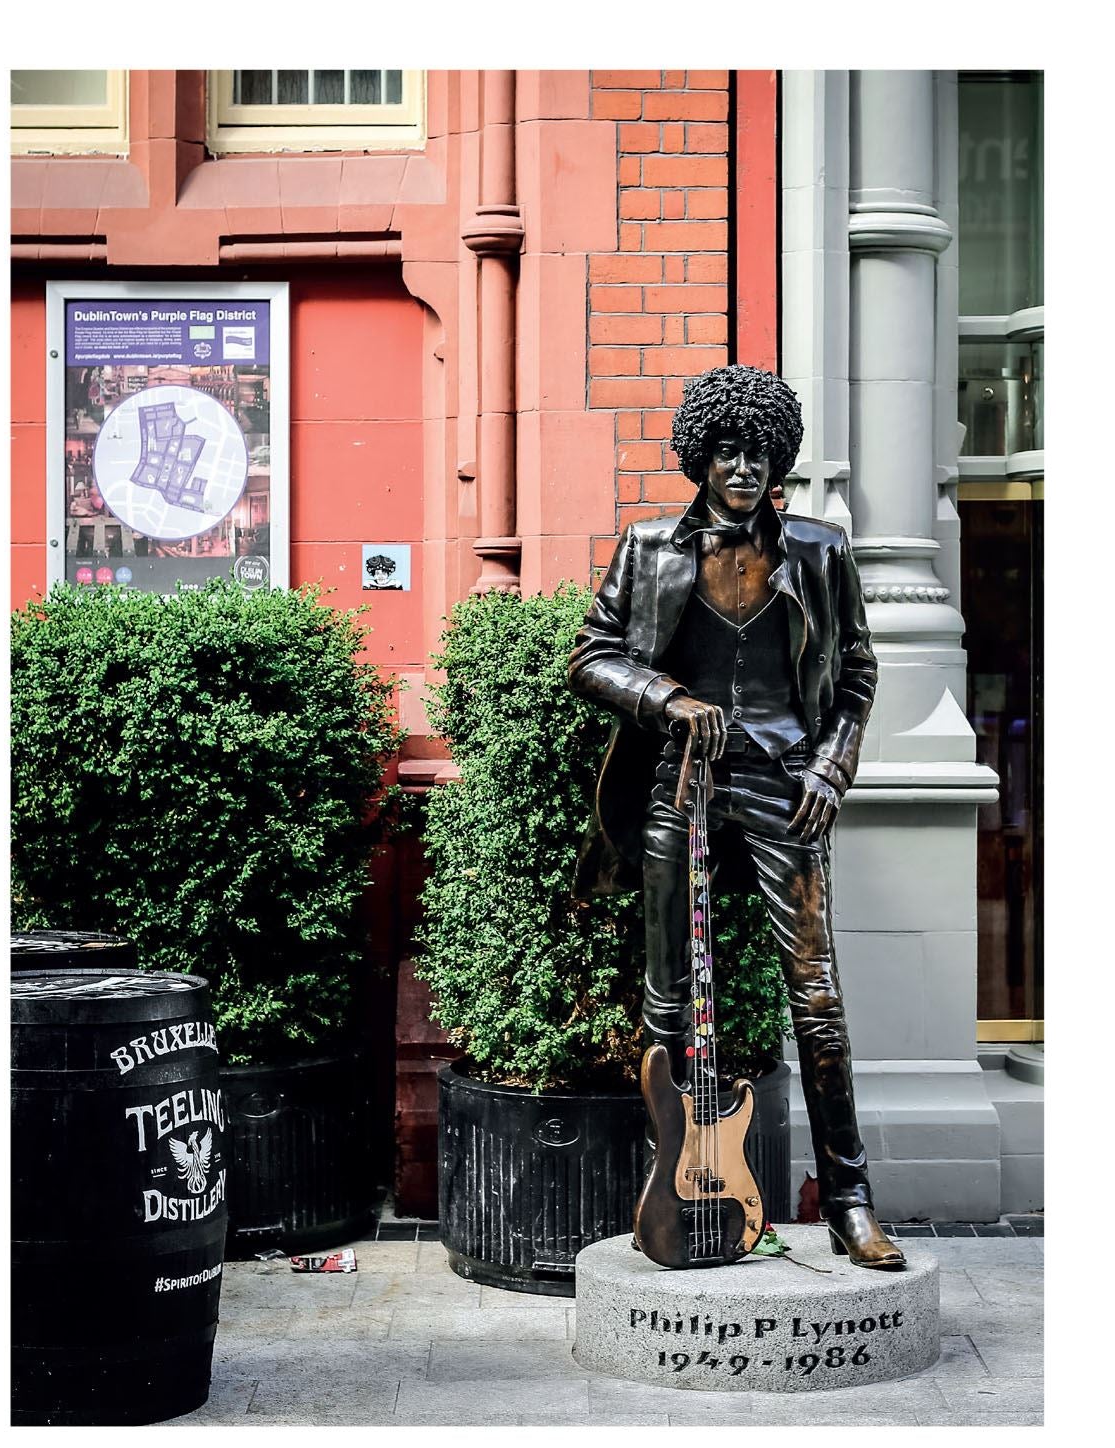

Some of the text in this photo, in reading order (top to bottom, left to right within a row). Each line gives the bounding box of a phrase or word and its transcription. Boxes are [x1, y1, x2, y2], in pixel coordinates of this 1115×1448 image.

[74, 310, 256, 323] DublinTown's Purple Flag District
[110, 1021, 220, 1075] BRUXELLE
[125, 1088, 225, 1152] TEELING
[143, 1168, 227, 1223] DISTILLERY
[629, 1308, 904, 1345] Philip P Lynott
[658, 1350, 750, 1376] 1949
[785, 1344, 873, 1376] 1986
